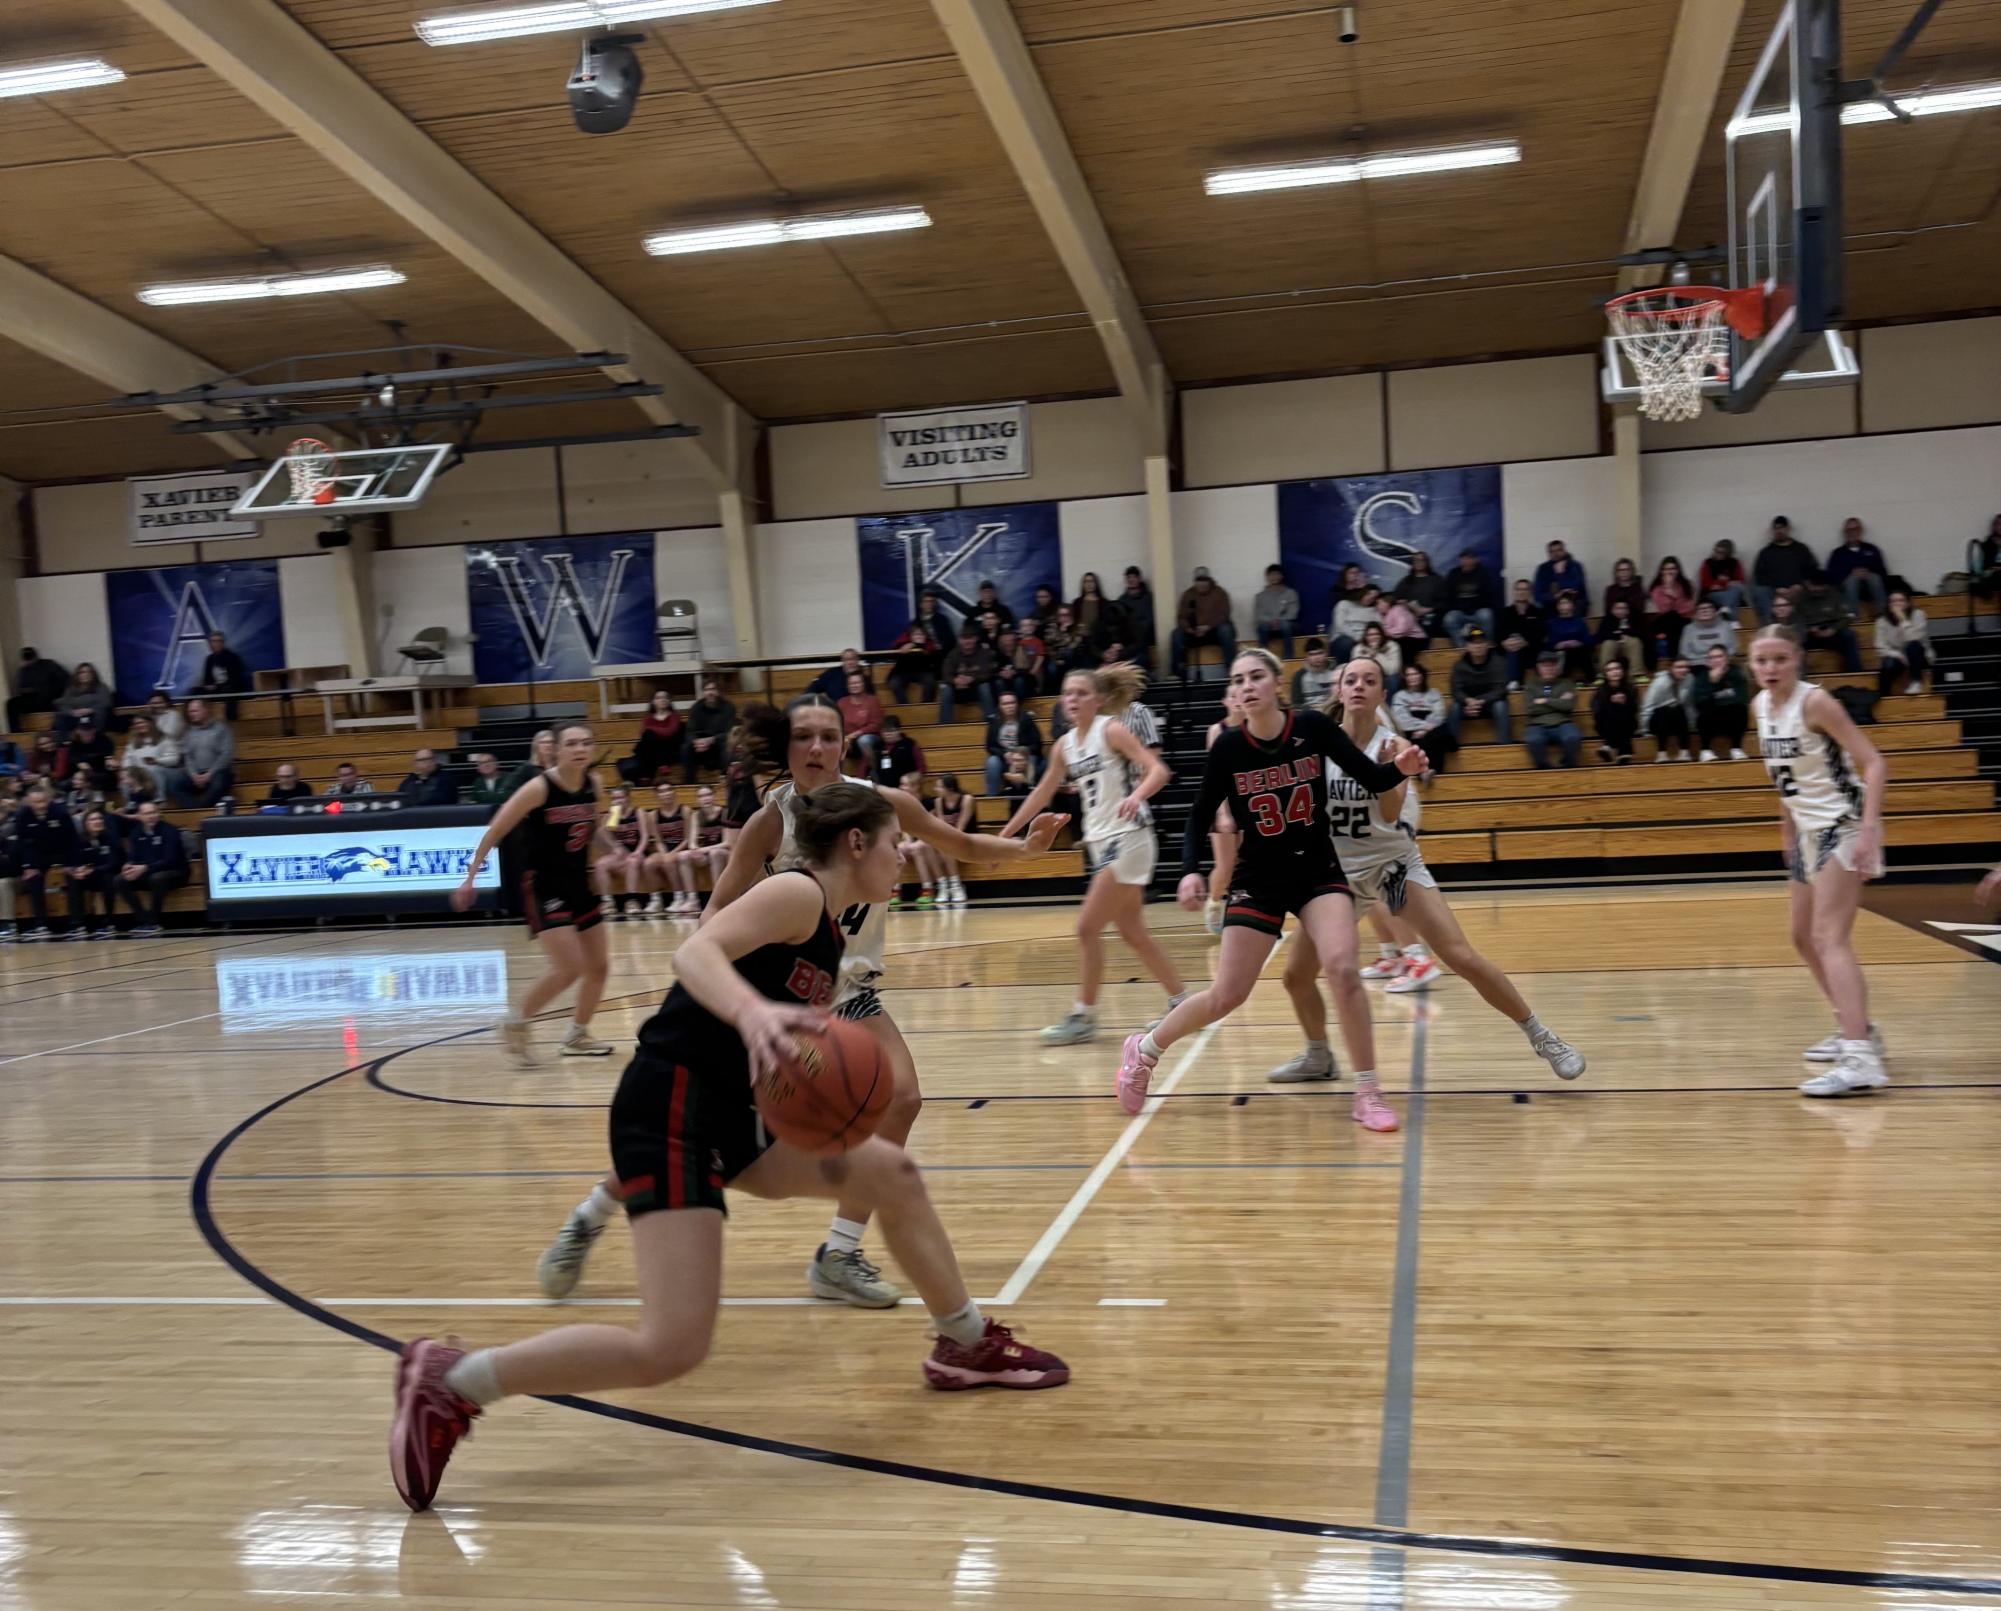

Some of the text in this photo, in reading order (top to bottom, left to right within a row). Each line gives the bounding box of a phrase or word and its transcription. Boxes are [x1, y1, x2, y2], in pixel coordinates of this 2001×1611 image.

[889, 421, 1018, 447] VISITING
[902, 446, 1008, 468] ADULTS
[141, 486, 240, 508] XAVIER
[139, 508, 234, 529] PARENT
[896, 522, 1009, 622] K
[495, 550, 634, 667] W
[153, 581, 218, 690] A
[1232, 754, 1321, 796] BERLIN
[1329, 779, 1379, 801] AVIE
[1248, 784, 1315, 837] 34
[1331, 806, 1373, 839] 22
